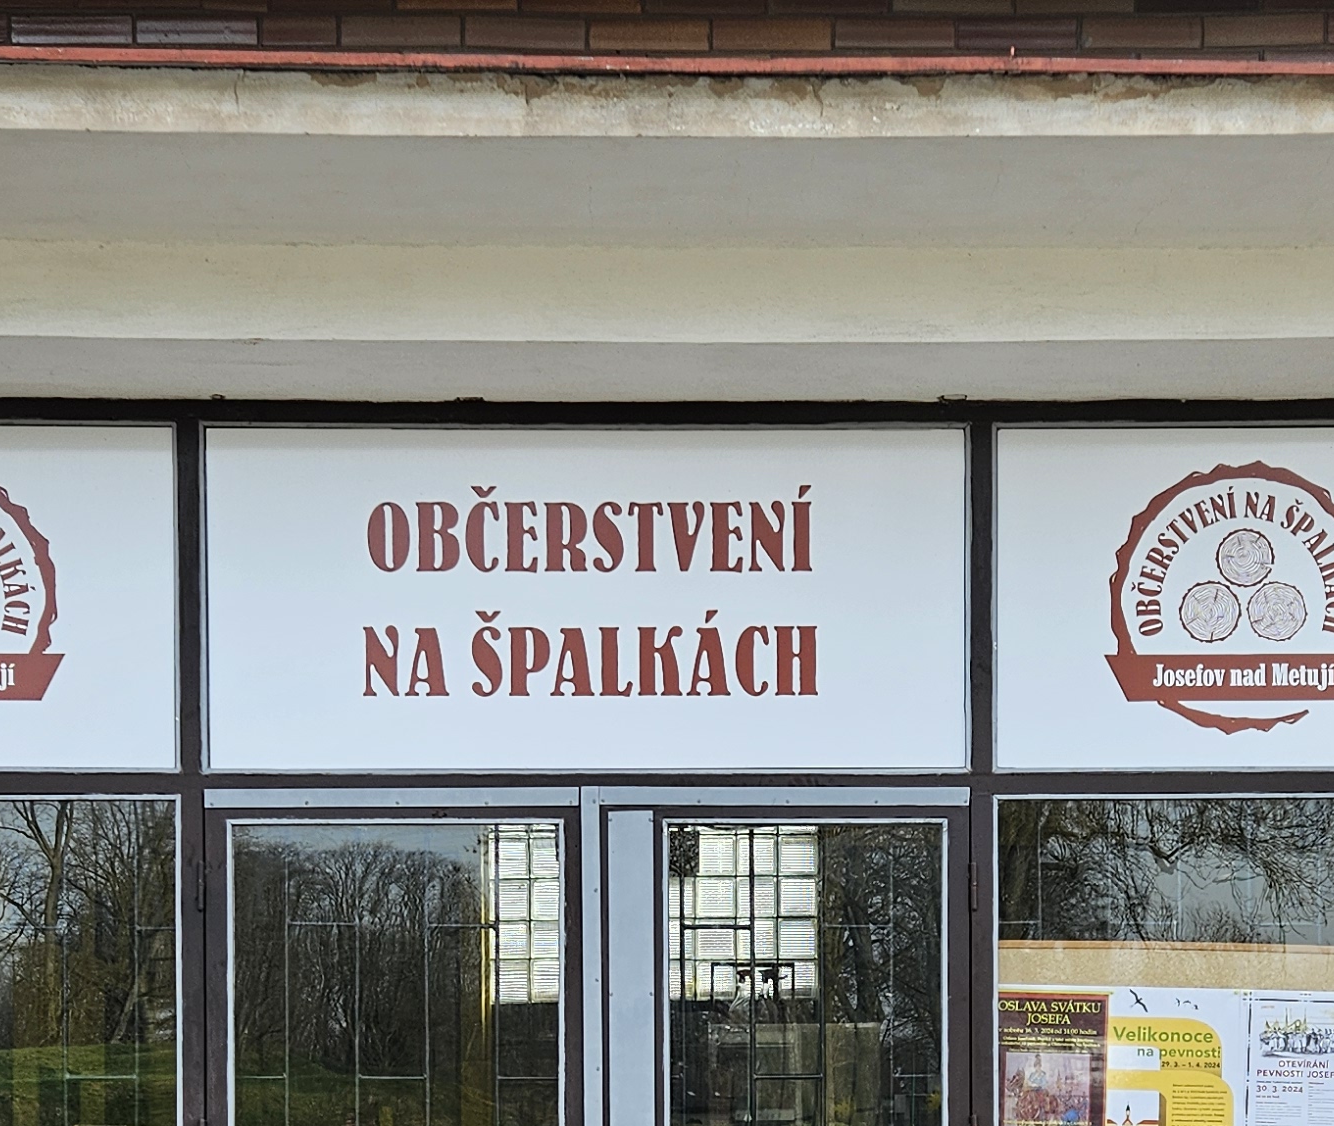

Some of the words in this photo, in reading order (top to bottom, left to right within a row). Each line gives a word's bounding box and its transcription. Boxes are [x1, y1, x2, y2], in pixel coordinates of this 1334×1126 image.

[367, 485, 813, 573] OBČERSTVENÍ
[1131, 486, 1237, 636] OBČERSTVENÍ
[1244, 491, 1276, 522] NA
[363, 624, 450, 697] NA
[471, 609, 818, 697] ŠPALKÁCH
[1153, 663, 1225, 687] Josefov
[1229, 665, 1266, 687] nad
[999, 1000, 1047, 1012] OSLAVA
[1051, 1000, 1101, 1013] SVÁTKU
[1026, 1013, 1071, 1026] JOSEFA
[1113, 1026, 1214, 1043] Velikonoce
[1137, 1048, 1154, 1057] na
[1159, 1046, 1222, 1060] pevnosti
[1278, 1059, 1330, 1069] OTEVÍRÁNÍ
[1256, 1069, 1304, 1078] PEVNOSTI
